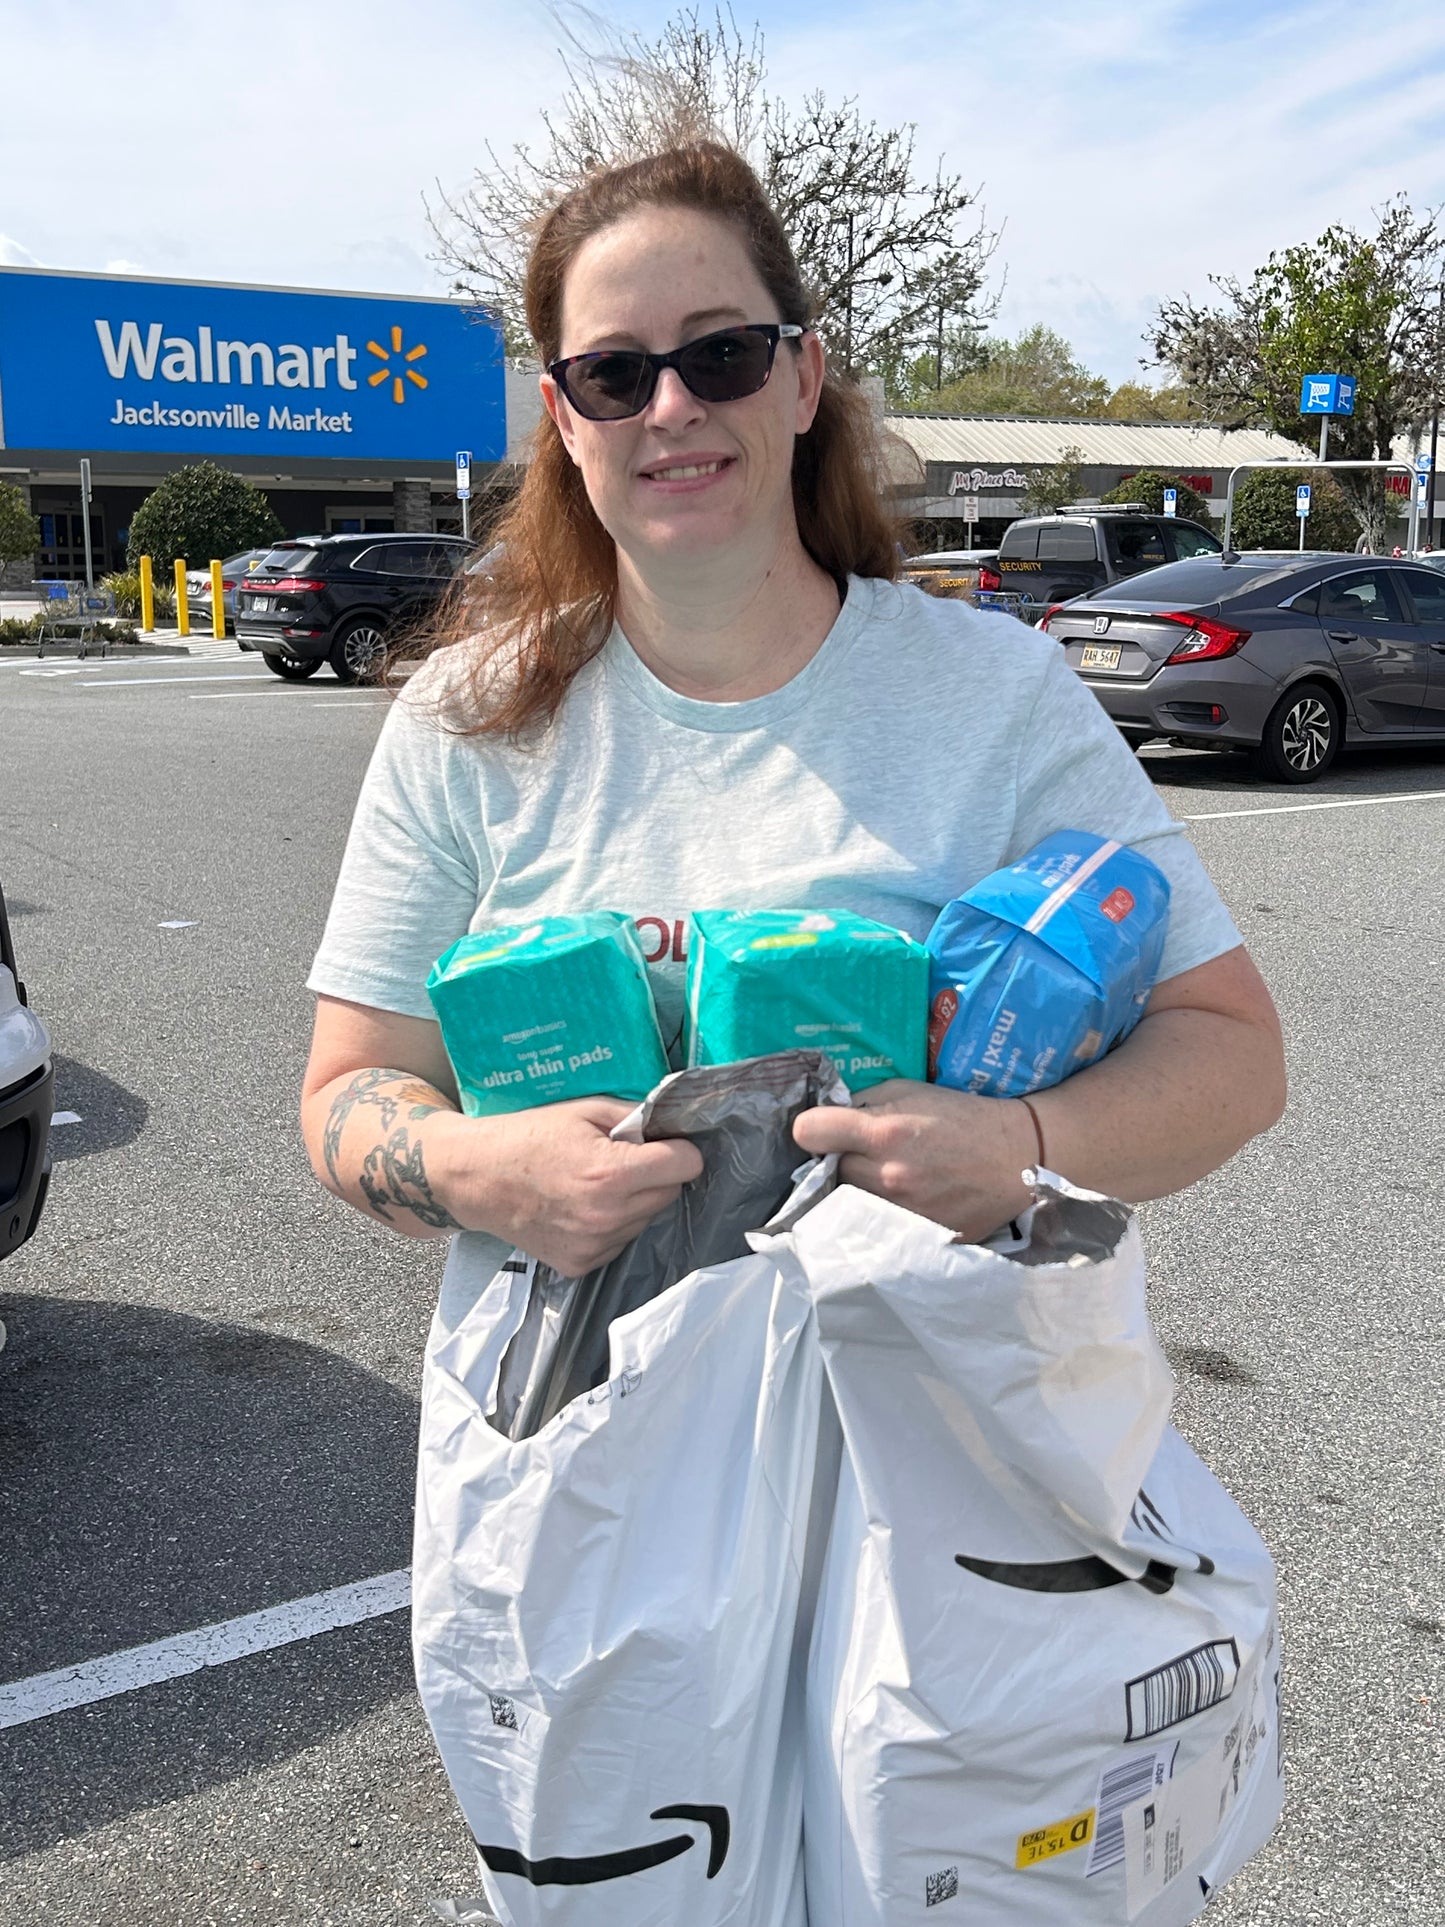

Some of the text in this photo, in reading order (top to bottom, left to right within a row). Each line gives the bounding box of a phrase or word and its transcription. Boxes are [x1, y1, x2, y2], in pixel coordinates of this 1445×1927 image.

[94, 319, 358, 390] Walmart
[110, 399, 353, 433] Jacksonville Market
[1000, 561, 1042, 572] SECURITY
[982, 1009, 1017, 1069] maxi
[483, 1045, 613, 1088] ultra thin pads
[1070, 1819, 1088, 1842] D
